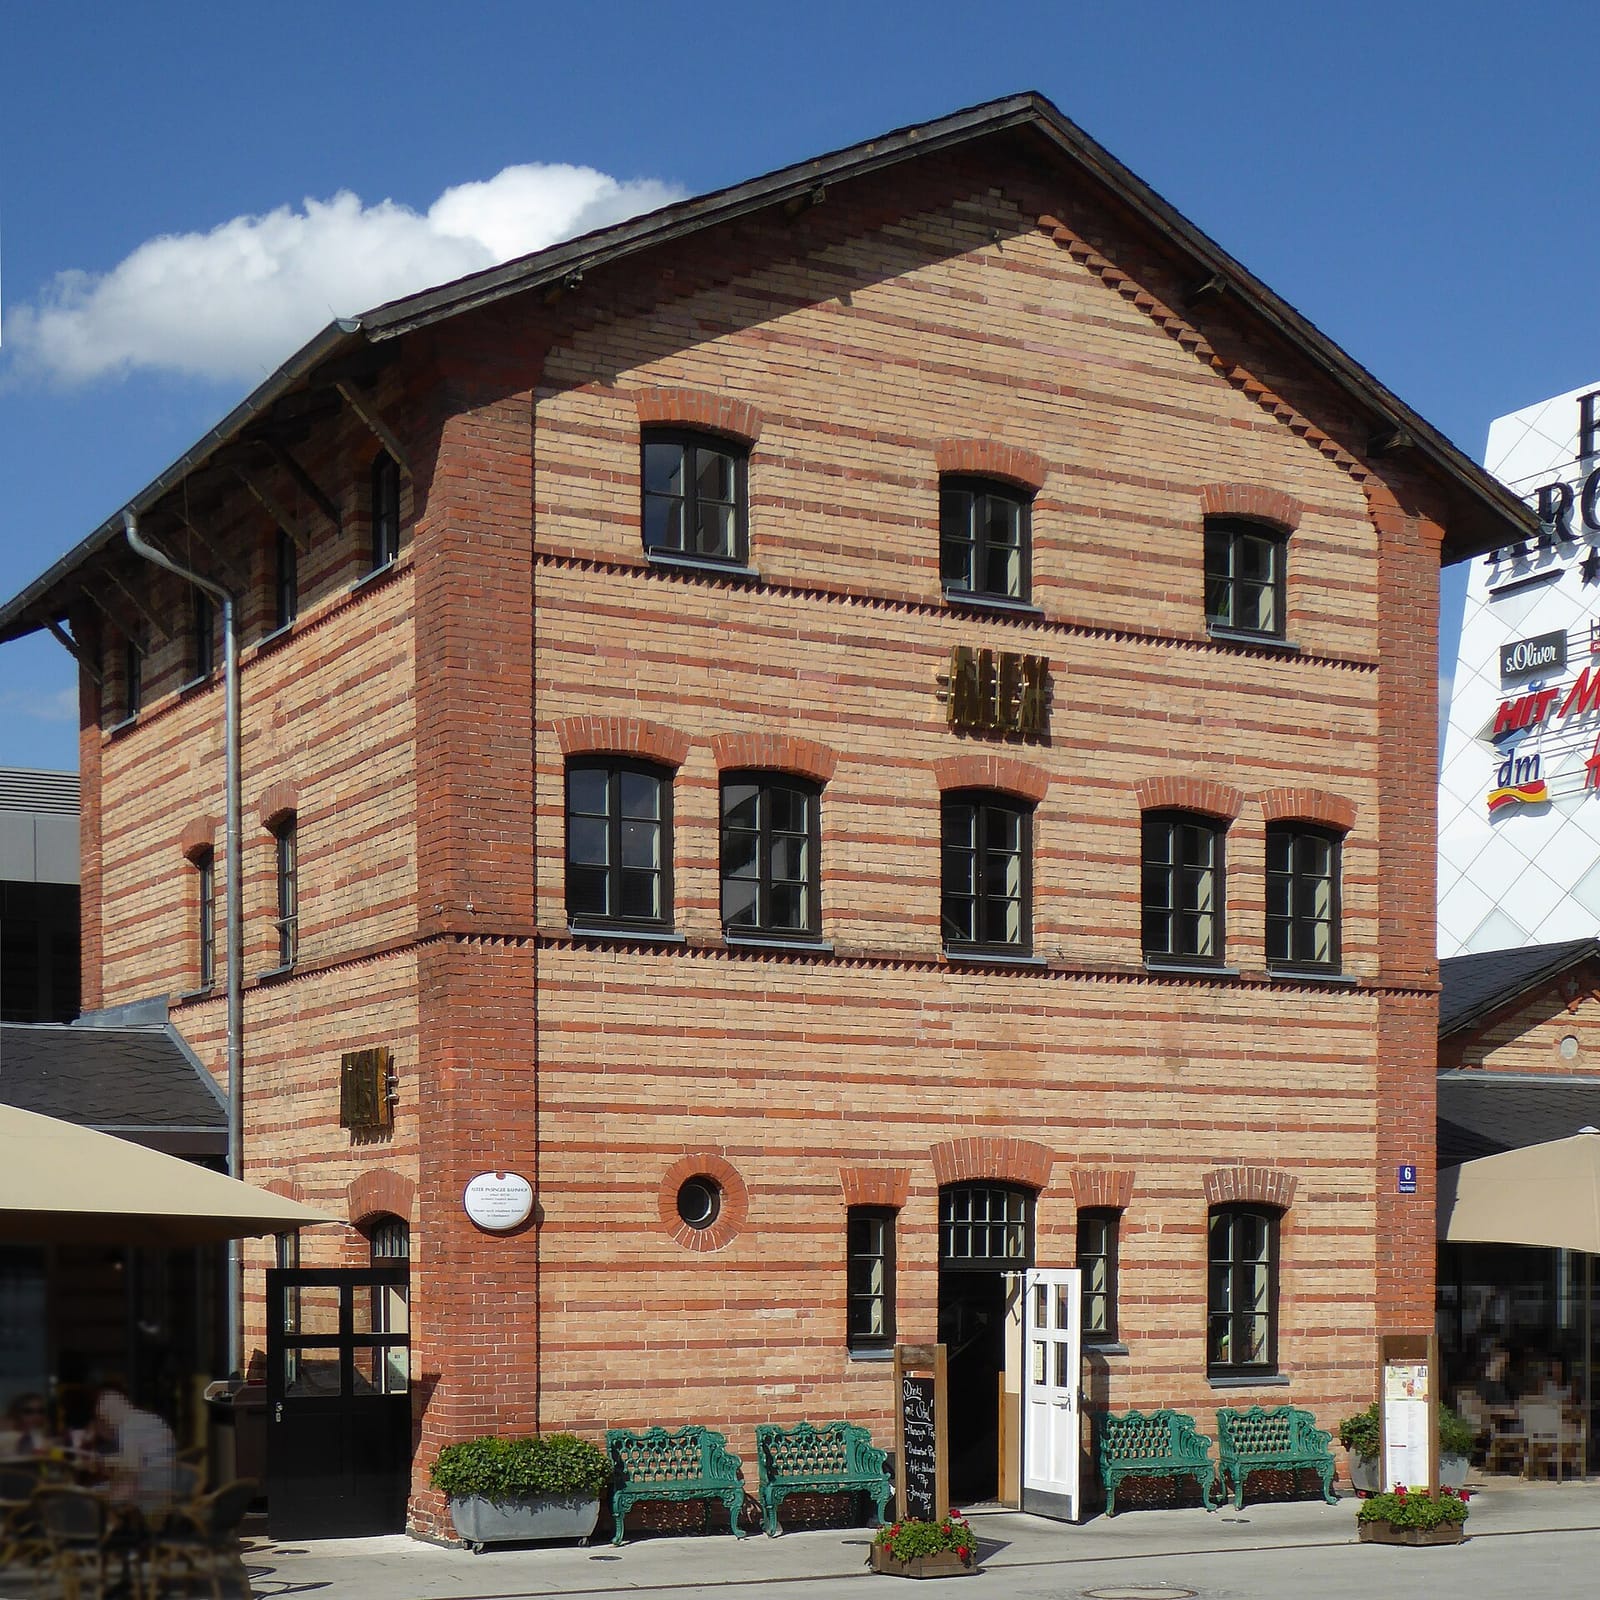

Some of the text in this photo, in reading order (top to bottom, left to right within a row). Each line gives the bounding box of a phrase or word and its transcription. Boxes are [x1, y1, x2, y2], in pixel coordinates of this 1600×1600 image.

[1505, 641, 1558, 673] s.Oliver
[1493, 687, 1561, 734] HIT
[1497, 747, 1541, 788] dm
[1404, 1167, 1412, 1180] 6
